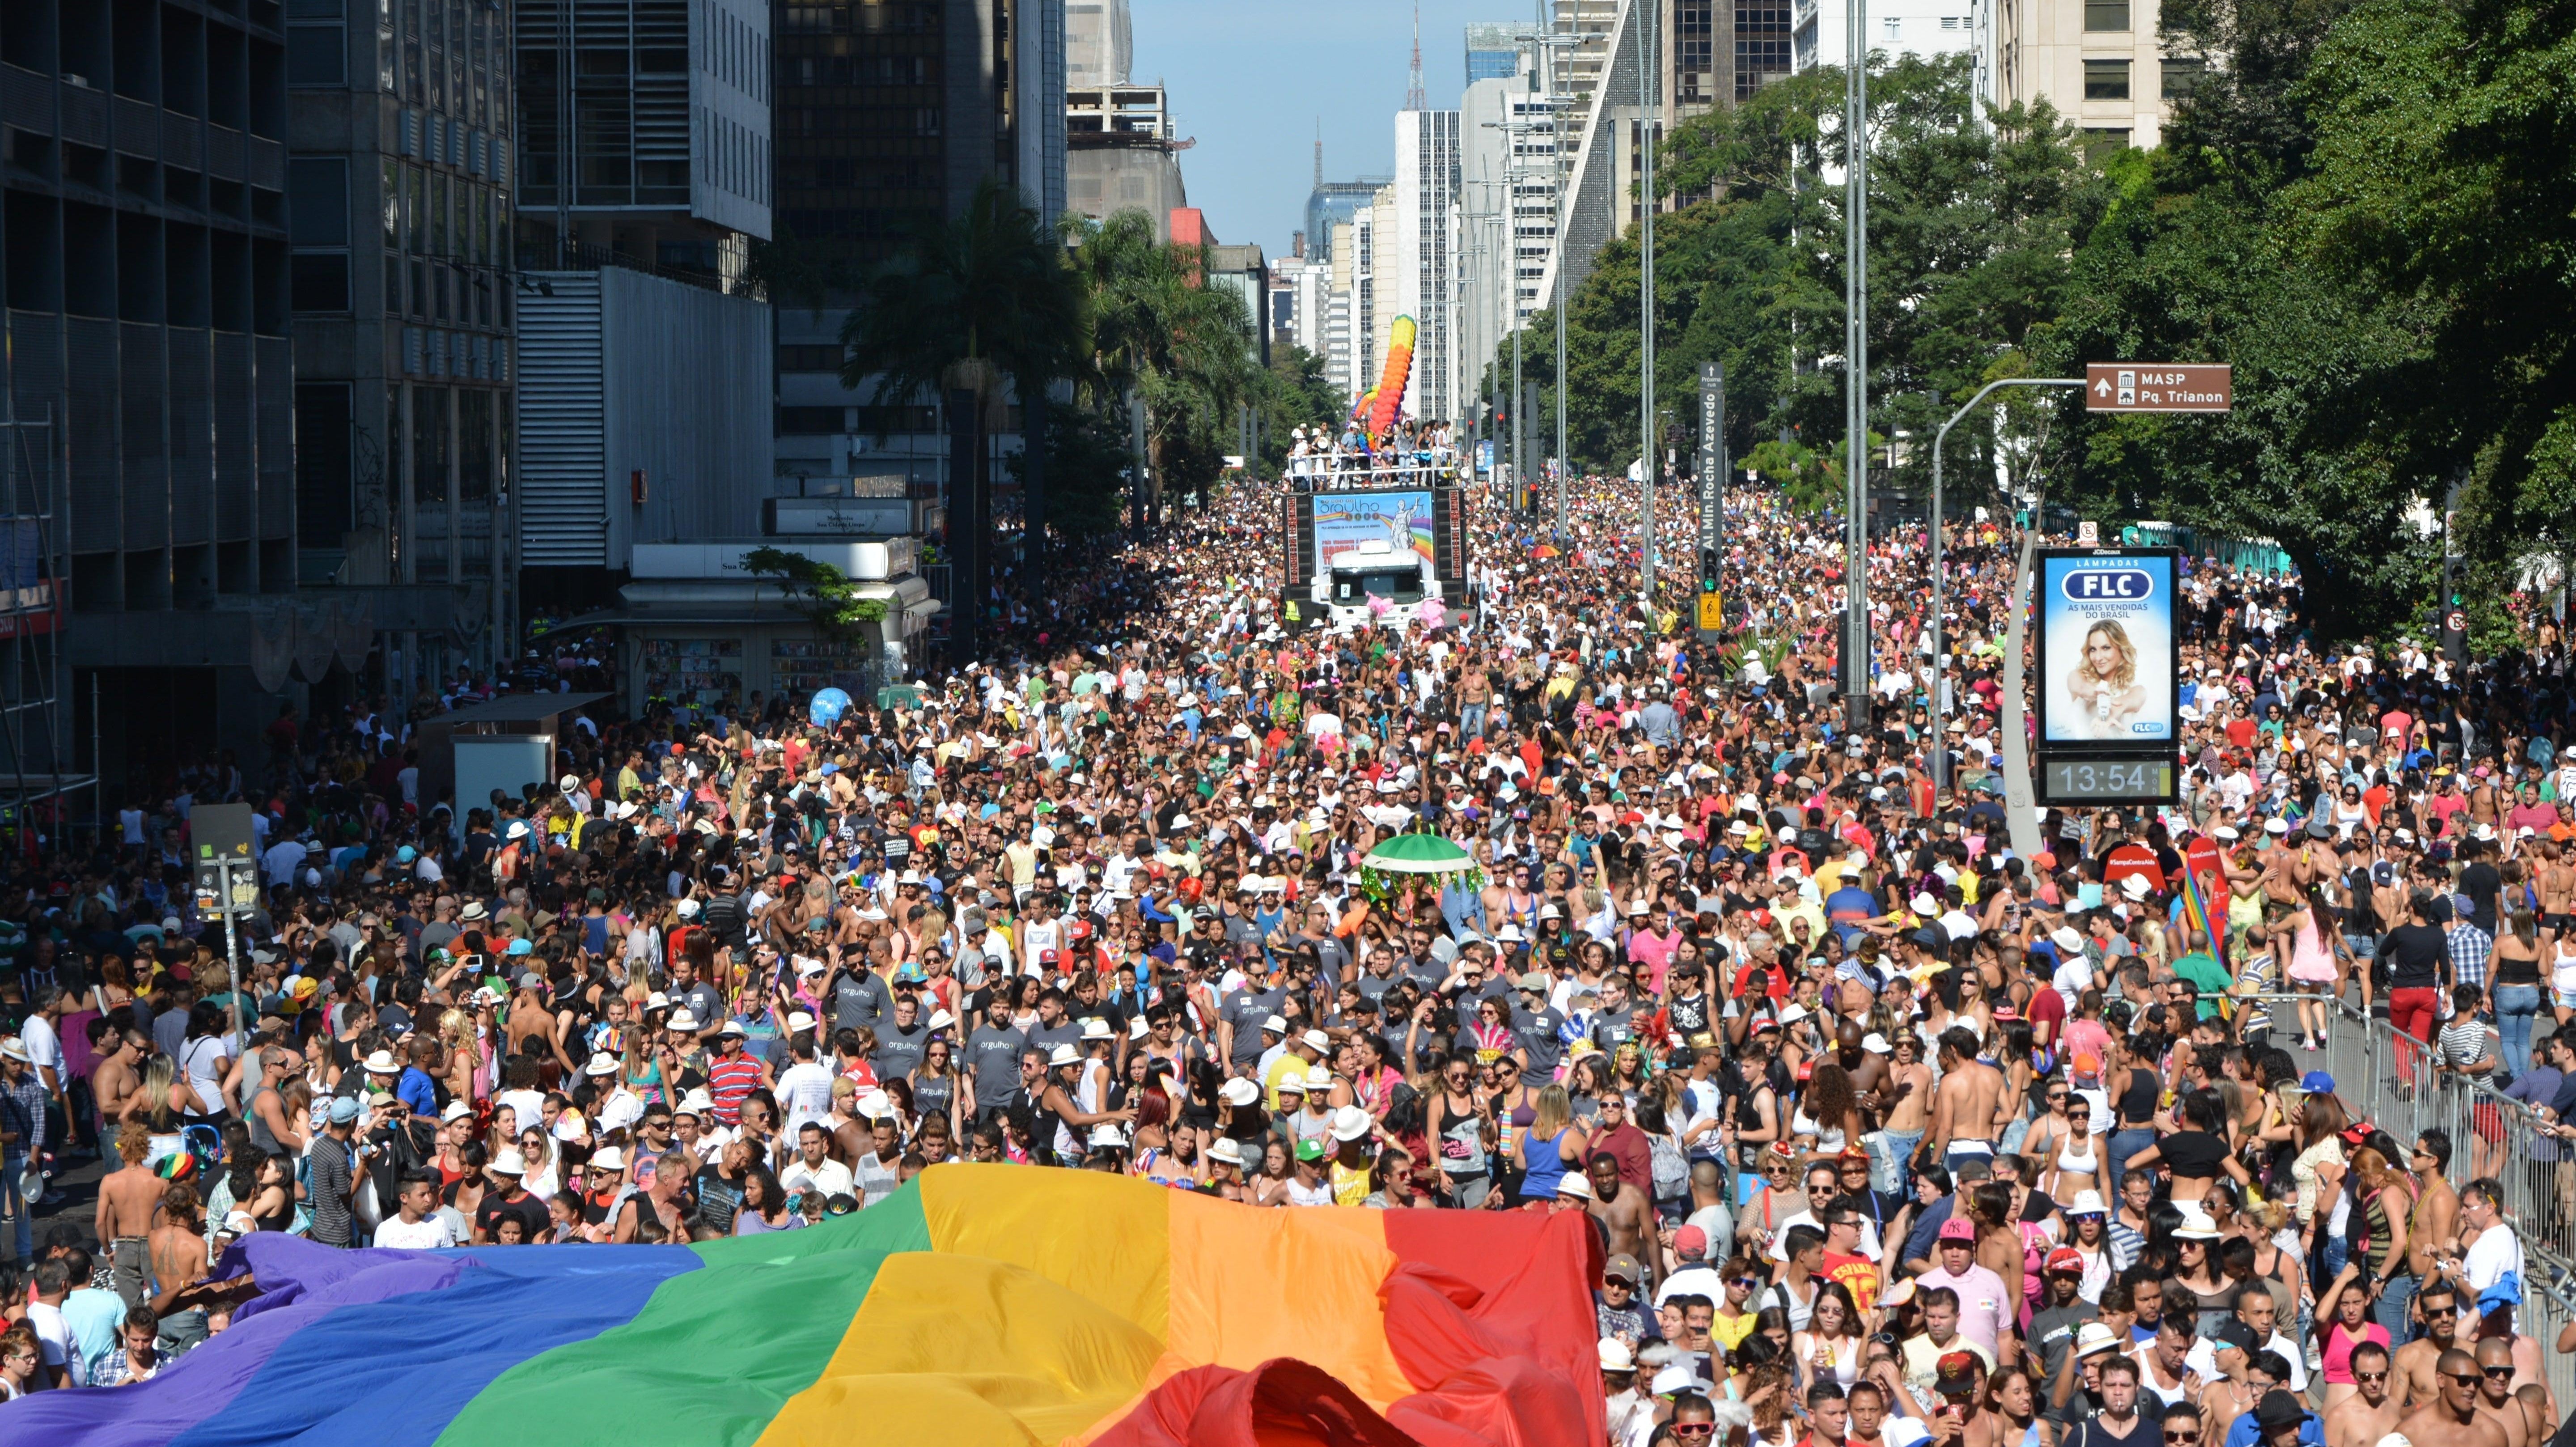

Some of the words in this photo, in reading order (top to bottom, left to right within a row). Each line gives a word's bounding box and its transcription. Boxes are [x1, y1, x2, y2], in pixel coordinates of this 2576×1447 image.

[2141, 373, 2186, 385] MASP
[2141, 390, 2162, 404] Pq.
[2167, 390, 2223, 403] Trianon
[1703, 393, 1716, 453] Azevedo
[1703, 457, 1715, 500] Rocha
[1320, 499, 1379, 517] orgulho
[1702, 501, 1714, 530] Min.
[1703, 532, 1714, 550] Al.
[2076, 559, 2139, 567] LÂMPADAS
[2083, 575, 2132, 596] FLC
[2060, 764, 2145, 792] 13:54
[843, 988, 870, 997] orgulho
[1242, 1005, 1268, 1015] orgulho
[888, 1041, 918, 1051] orgulho
[980, 1040, 1009, 1050] orgulho
[1038, 1041, 1062, 1050] orgulh
